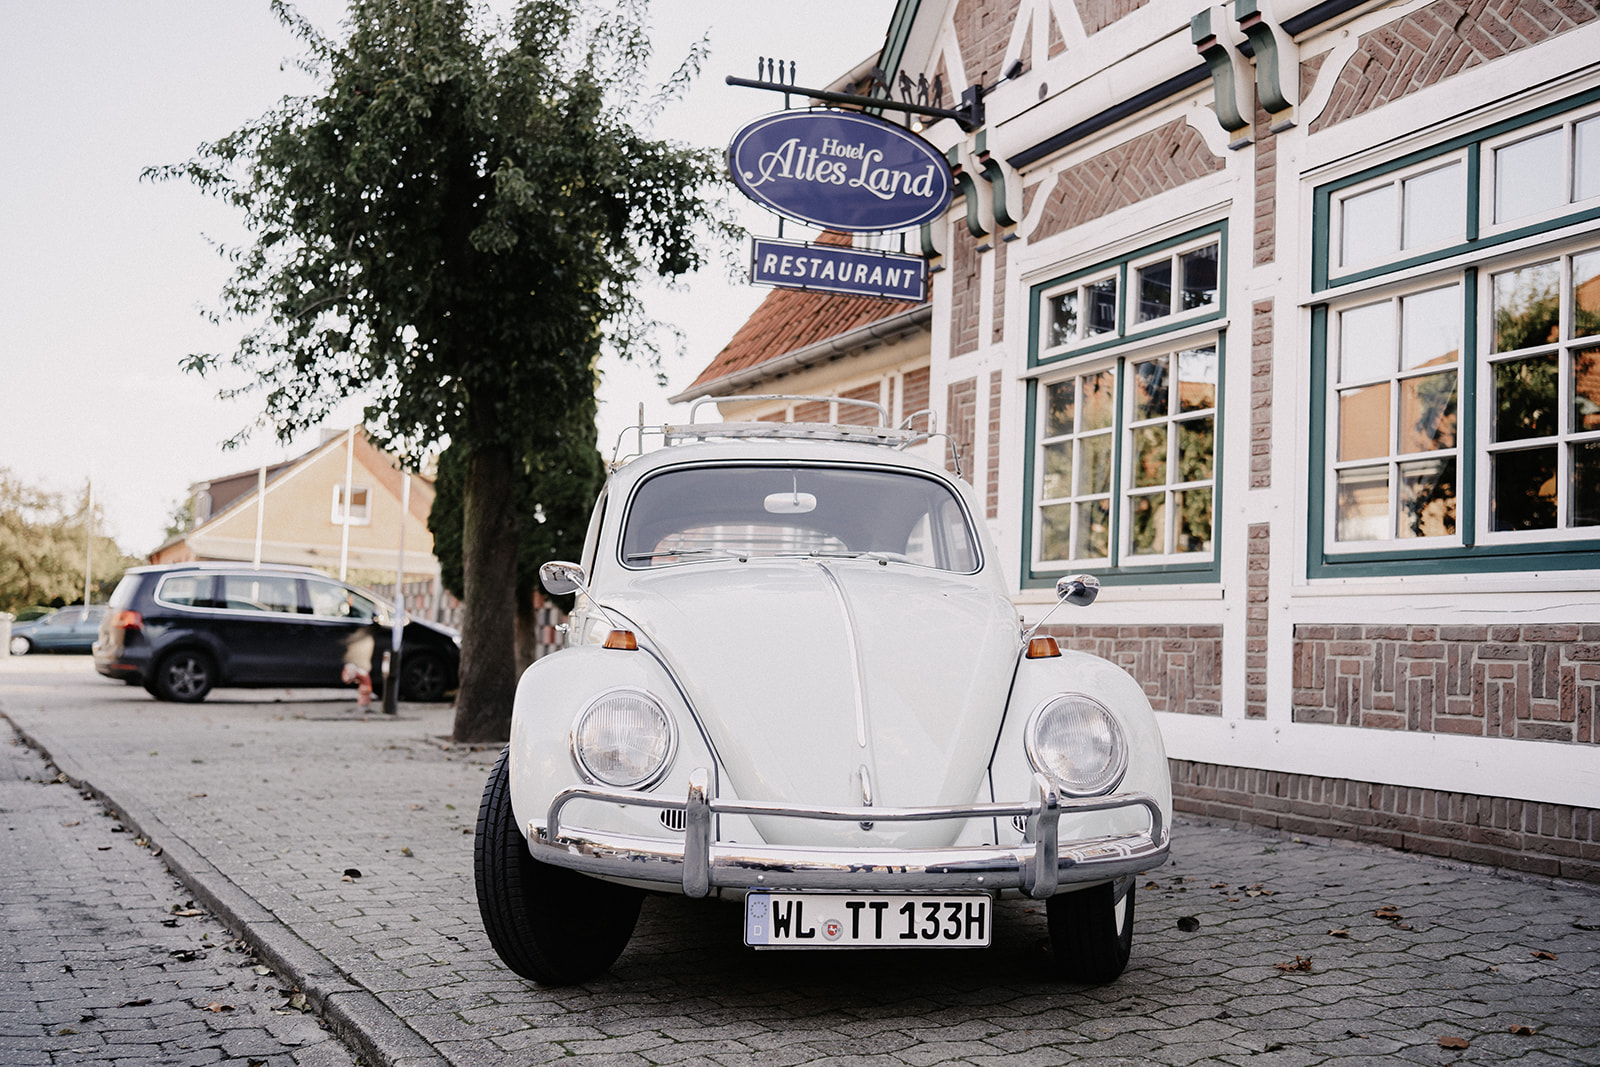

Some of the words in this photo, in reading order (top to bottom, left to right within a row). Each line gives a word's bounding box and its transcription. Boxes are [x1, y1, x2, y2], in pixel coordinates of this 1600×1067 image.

[821, 137, 865, 160] Hotel
[743, 138, 848, 187] Altes
[849, 149, 935, 200] Land
[763, 253, 915, 289] RESTAURANT
[753, 925, 762, 936] D
[772, 900, 815, 939] WL
[845, 901, 889, 939] TT
[899, 901, 986, 940] 133H
